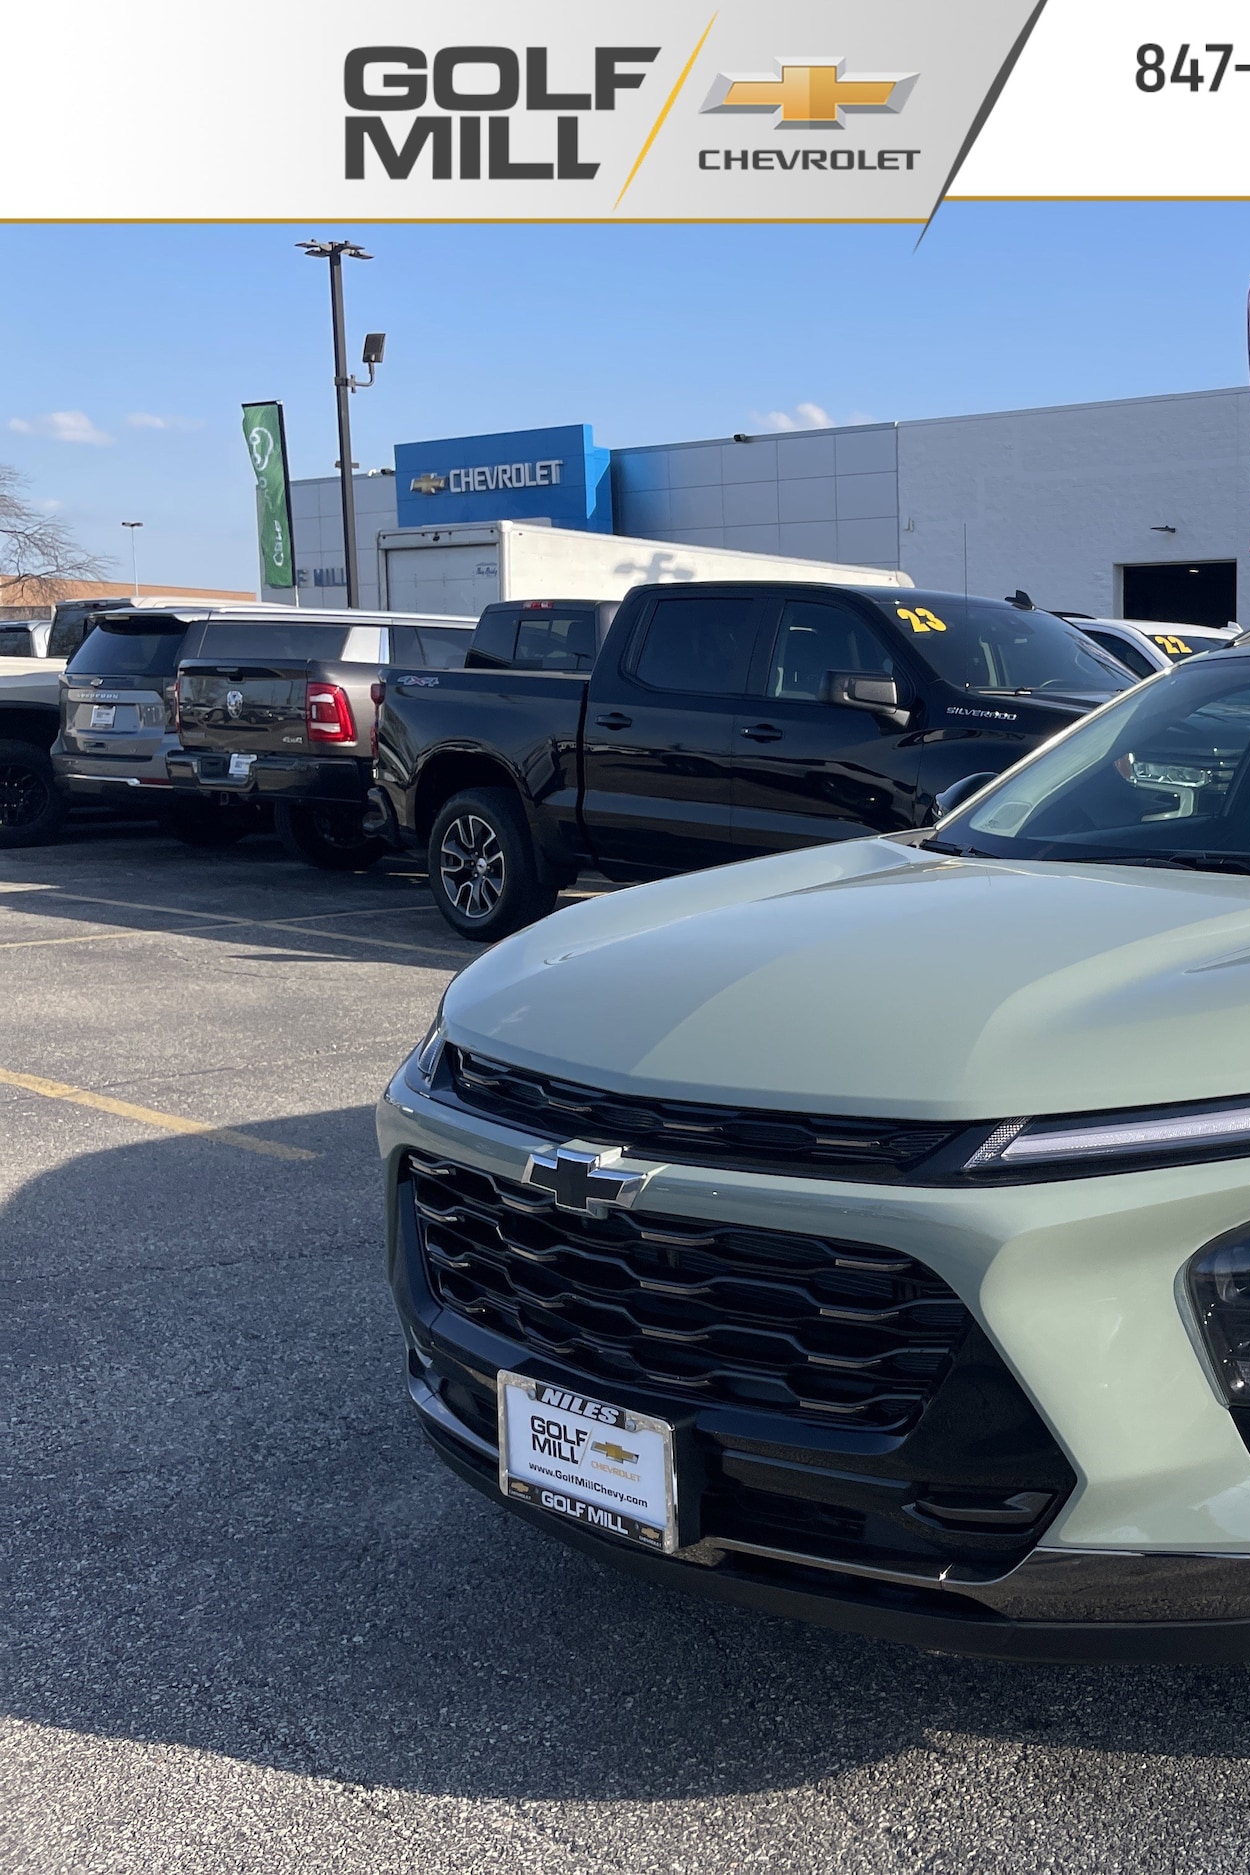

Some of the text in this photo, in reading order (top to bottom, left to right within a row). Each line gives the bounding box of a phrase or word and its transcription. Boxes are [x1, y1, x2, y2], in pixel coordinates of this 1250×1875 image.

[450, 460, 563, 493] CHEVROLET
[313, 567, 347, 587] MILL
[896, 607, 947, 633] 23
[1154, 635, 1192, 654] 22
[946, 706, 1017, 721] SILVERADO
[541, 1387, 619, 1424] NILES
[530, 1415, 588, 1447] GOLF
[531, 1433, 579, 1465] MILL
[528, 1461, 648, 1508] www.GolfMillChevy.com
[590, 1460, 641, 1483] CHEVROLET
[541, 1490, 629, 1535] GOLF MILL
